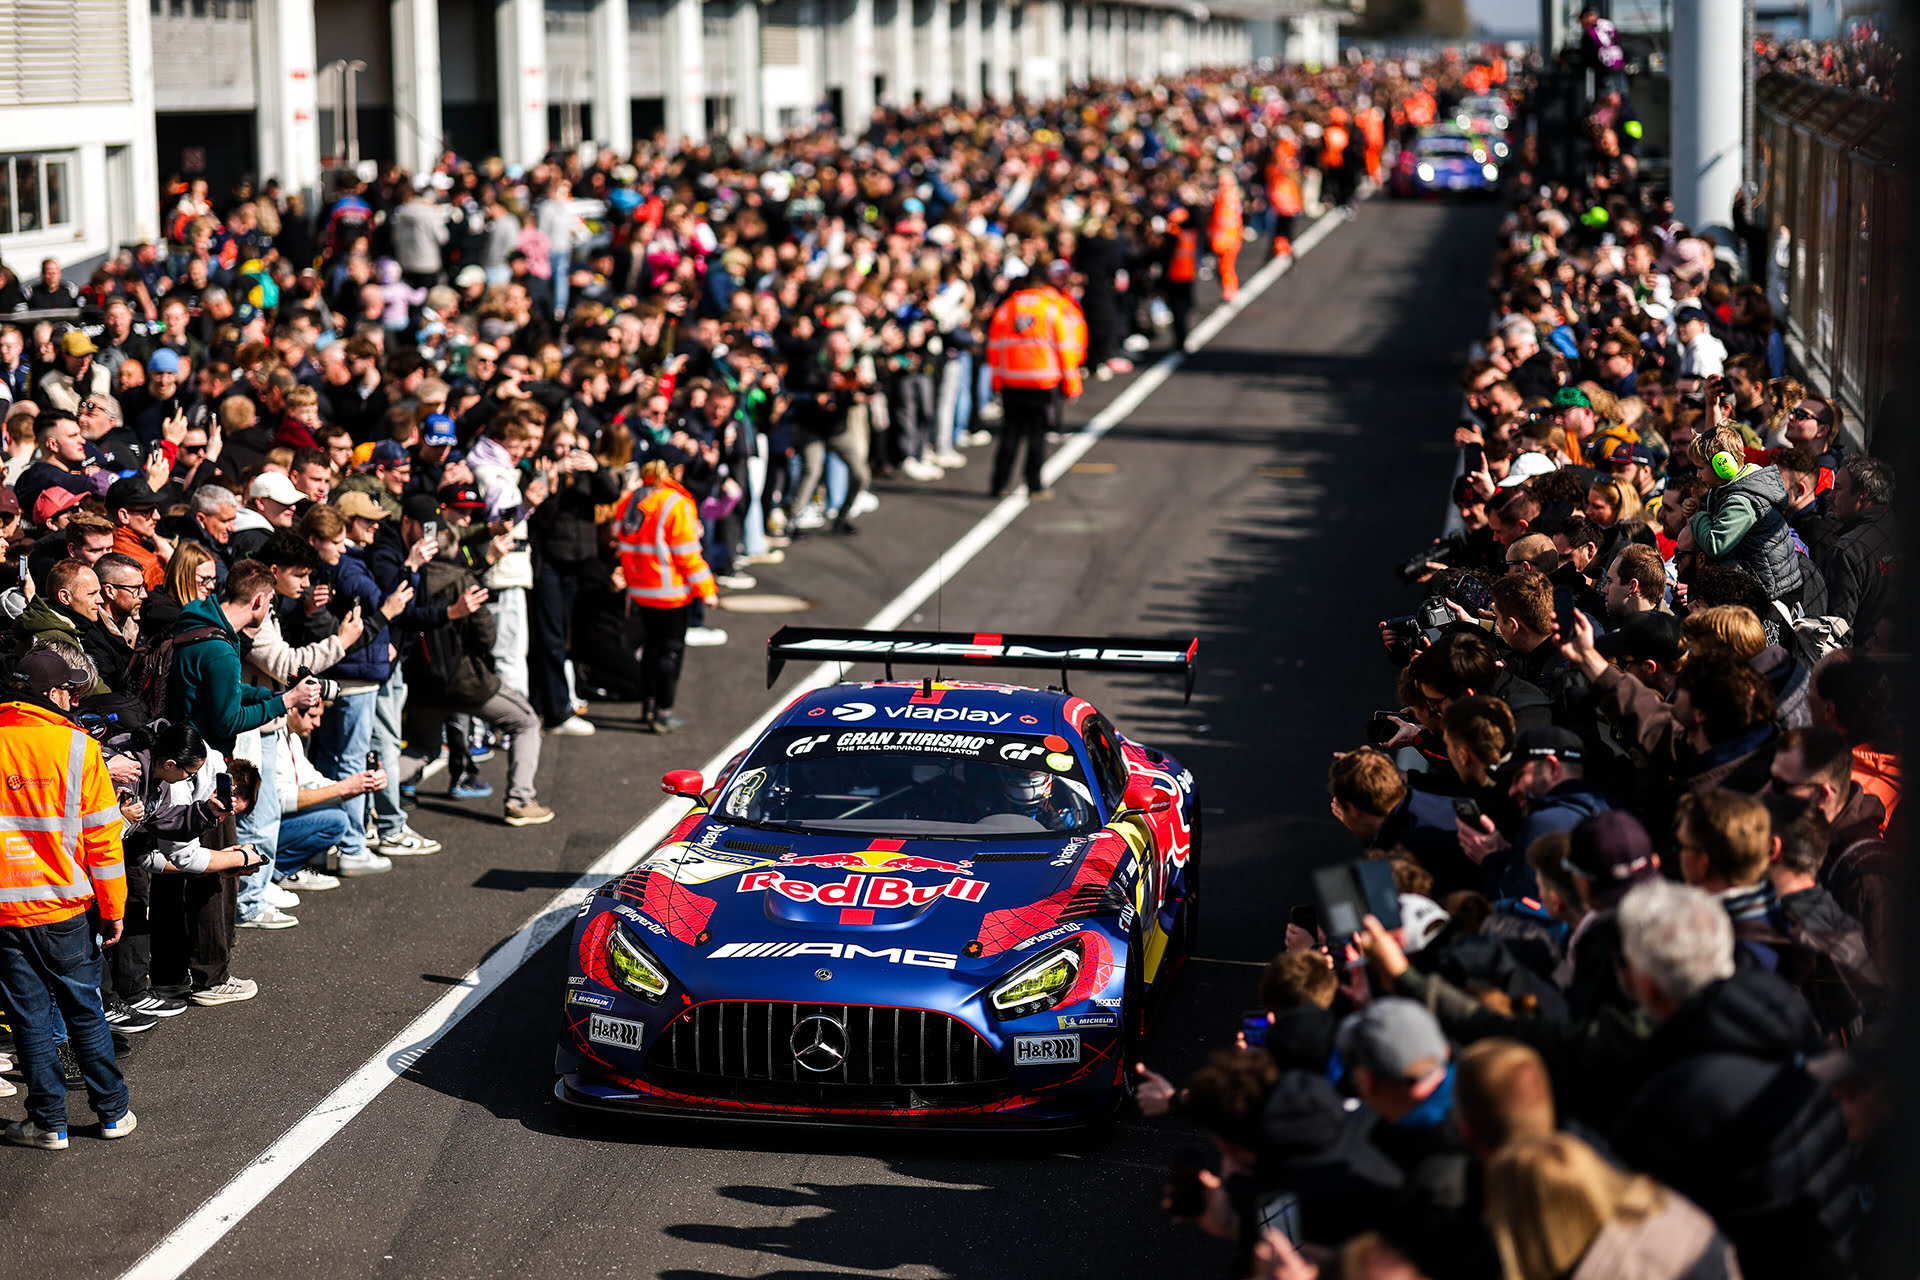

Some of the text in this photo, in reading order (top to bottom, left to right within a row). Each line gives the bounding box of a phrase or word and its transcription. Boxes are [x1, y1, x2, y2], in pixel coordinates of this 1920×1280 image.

[884, 704, 1012, 725] viaplay
[836, 731, 895, 746] GRAN
[924, 746, 980, 756] SIMULATOR
[736, 870, 990, 909] Red Bull
[780, 942, 958, 969] AMG
[578, 995, 609, 1006] MICHELIN
[1079, 1017, 1114, 1025] MICHELIN
